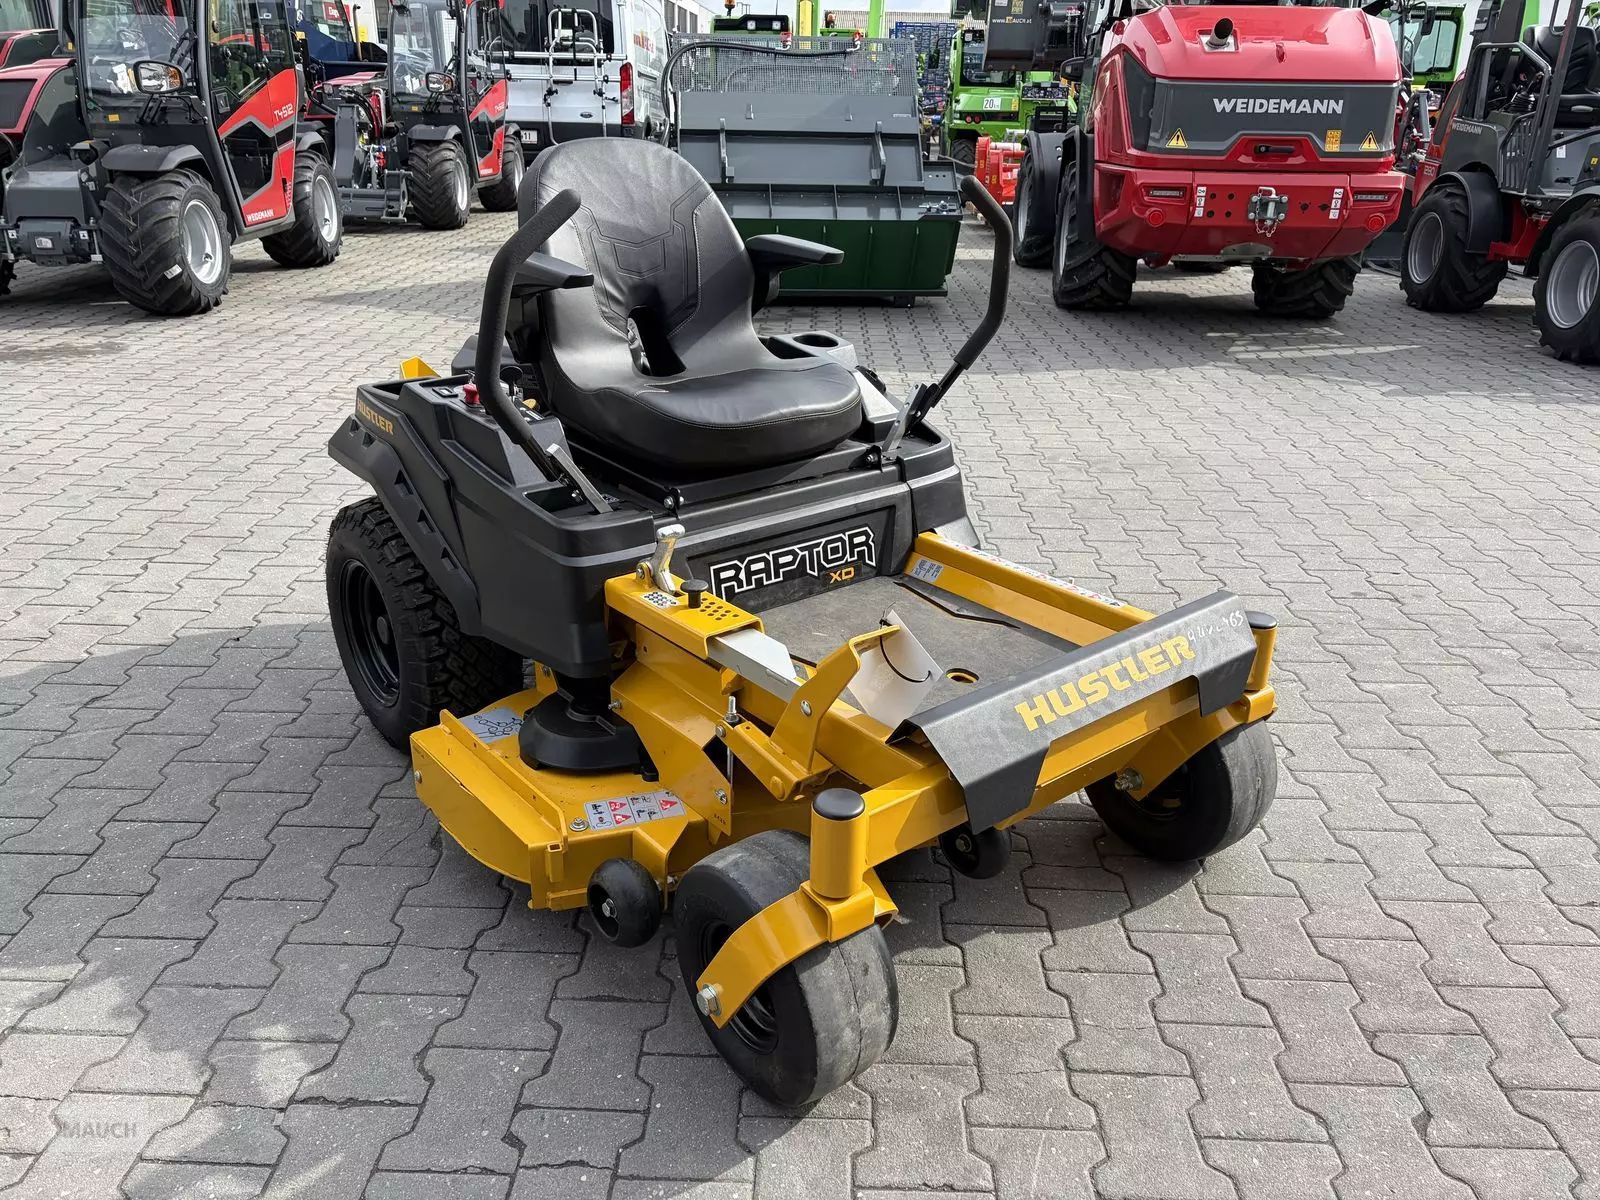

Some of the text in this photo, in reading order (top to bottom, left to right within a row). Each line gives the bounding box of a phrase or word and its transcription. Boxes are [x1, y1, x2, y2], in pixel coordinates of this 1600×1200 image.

[984, 98, 994, 109] 20
[1213, 98, 1344, 114] WEIDEMANN
[1452, 122, 1482, 135] WEIDEMANN
[246, 208, 274, 222] WEIDEMANN
[357, 397, 394, 435] HUSTLER
[710, 526, 876, 601] RAPTOR
[829, 566, 855, 584] XD
[1014, 635, 1196, 732] HUSTLER
